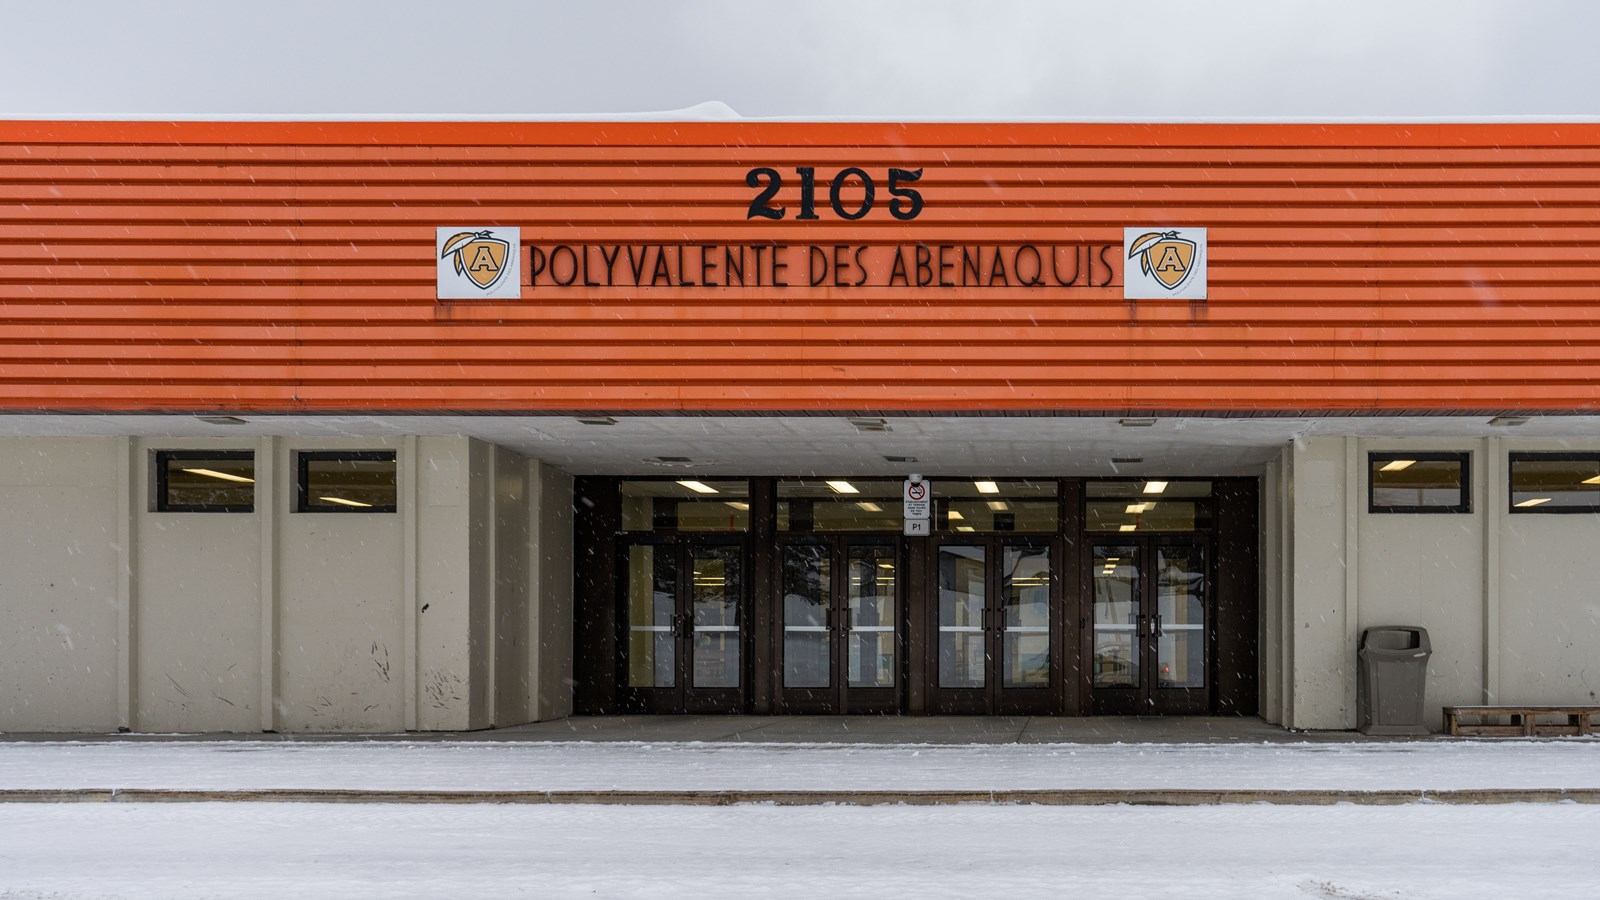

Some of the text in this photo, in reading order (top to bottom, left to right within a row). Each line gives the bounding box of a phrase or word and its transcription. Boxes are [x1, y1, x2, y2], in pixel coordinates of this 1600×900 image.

[746, 167, 923, 220] 2105
[470, 246, 499, 272] A
[530, 244, 788, 287] POLYVALENTE
[810, 244, 868, 287] DES
[889, 244, 1113, 287] ABENAQUIS
[1156, 246, 1186, 272] A
[912, 523, 921, 531] P1
